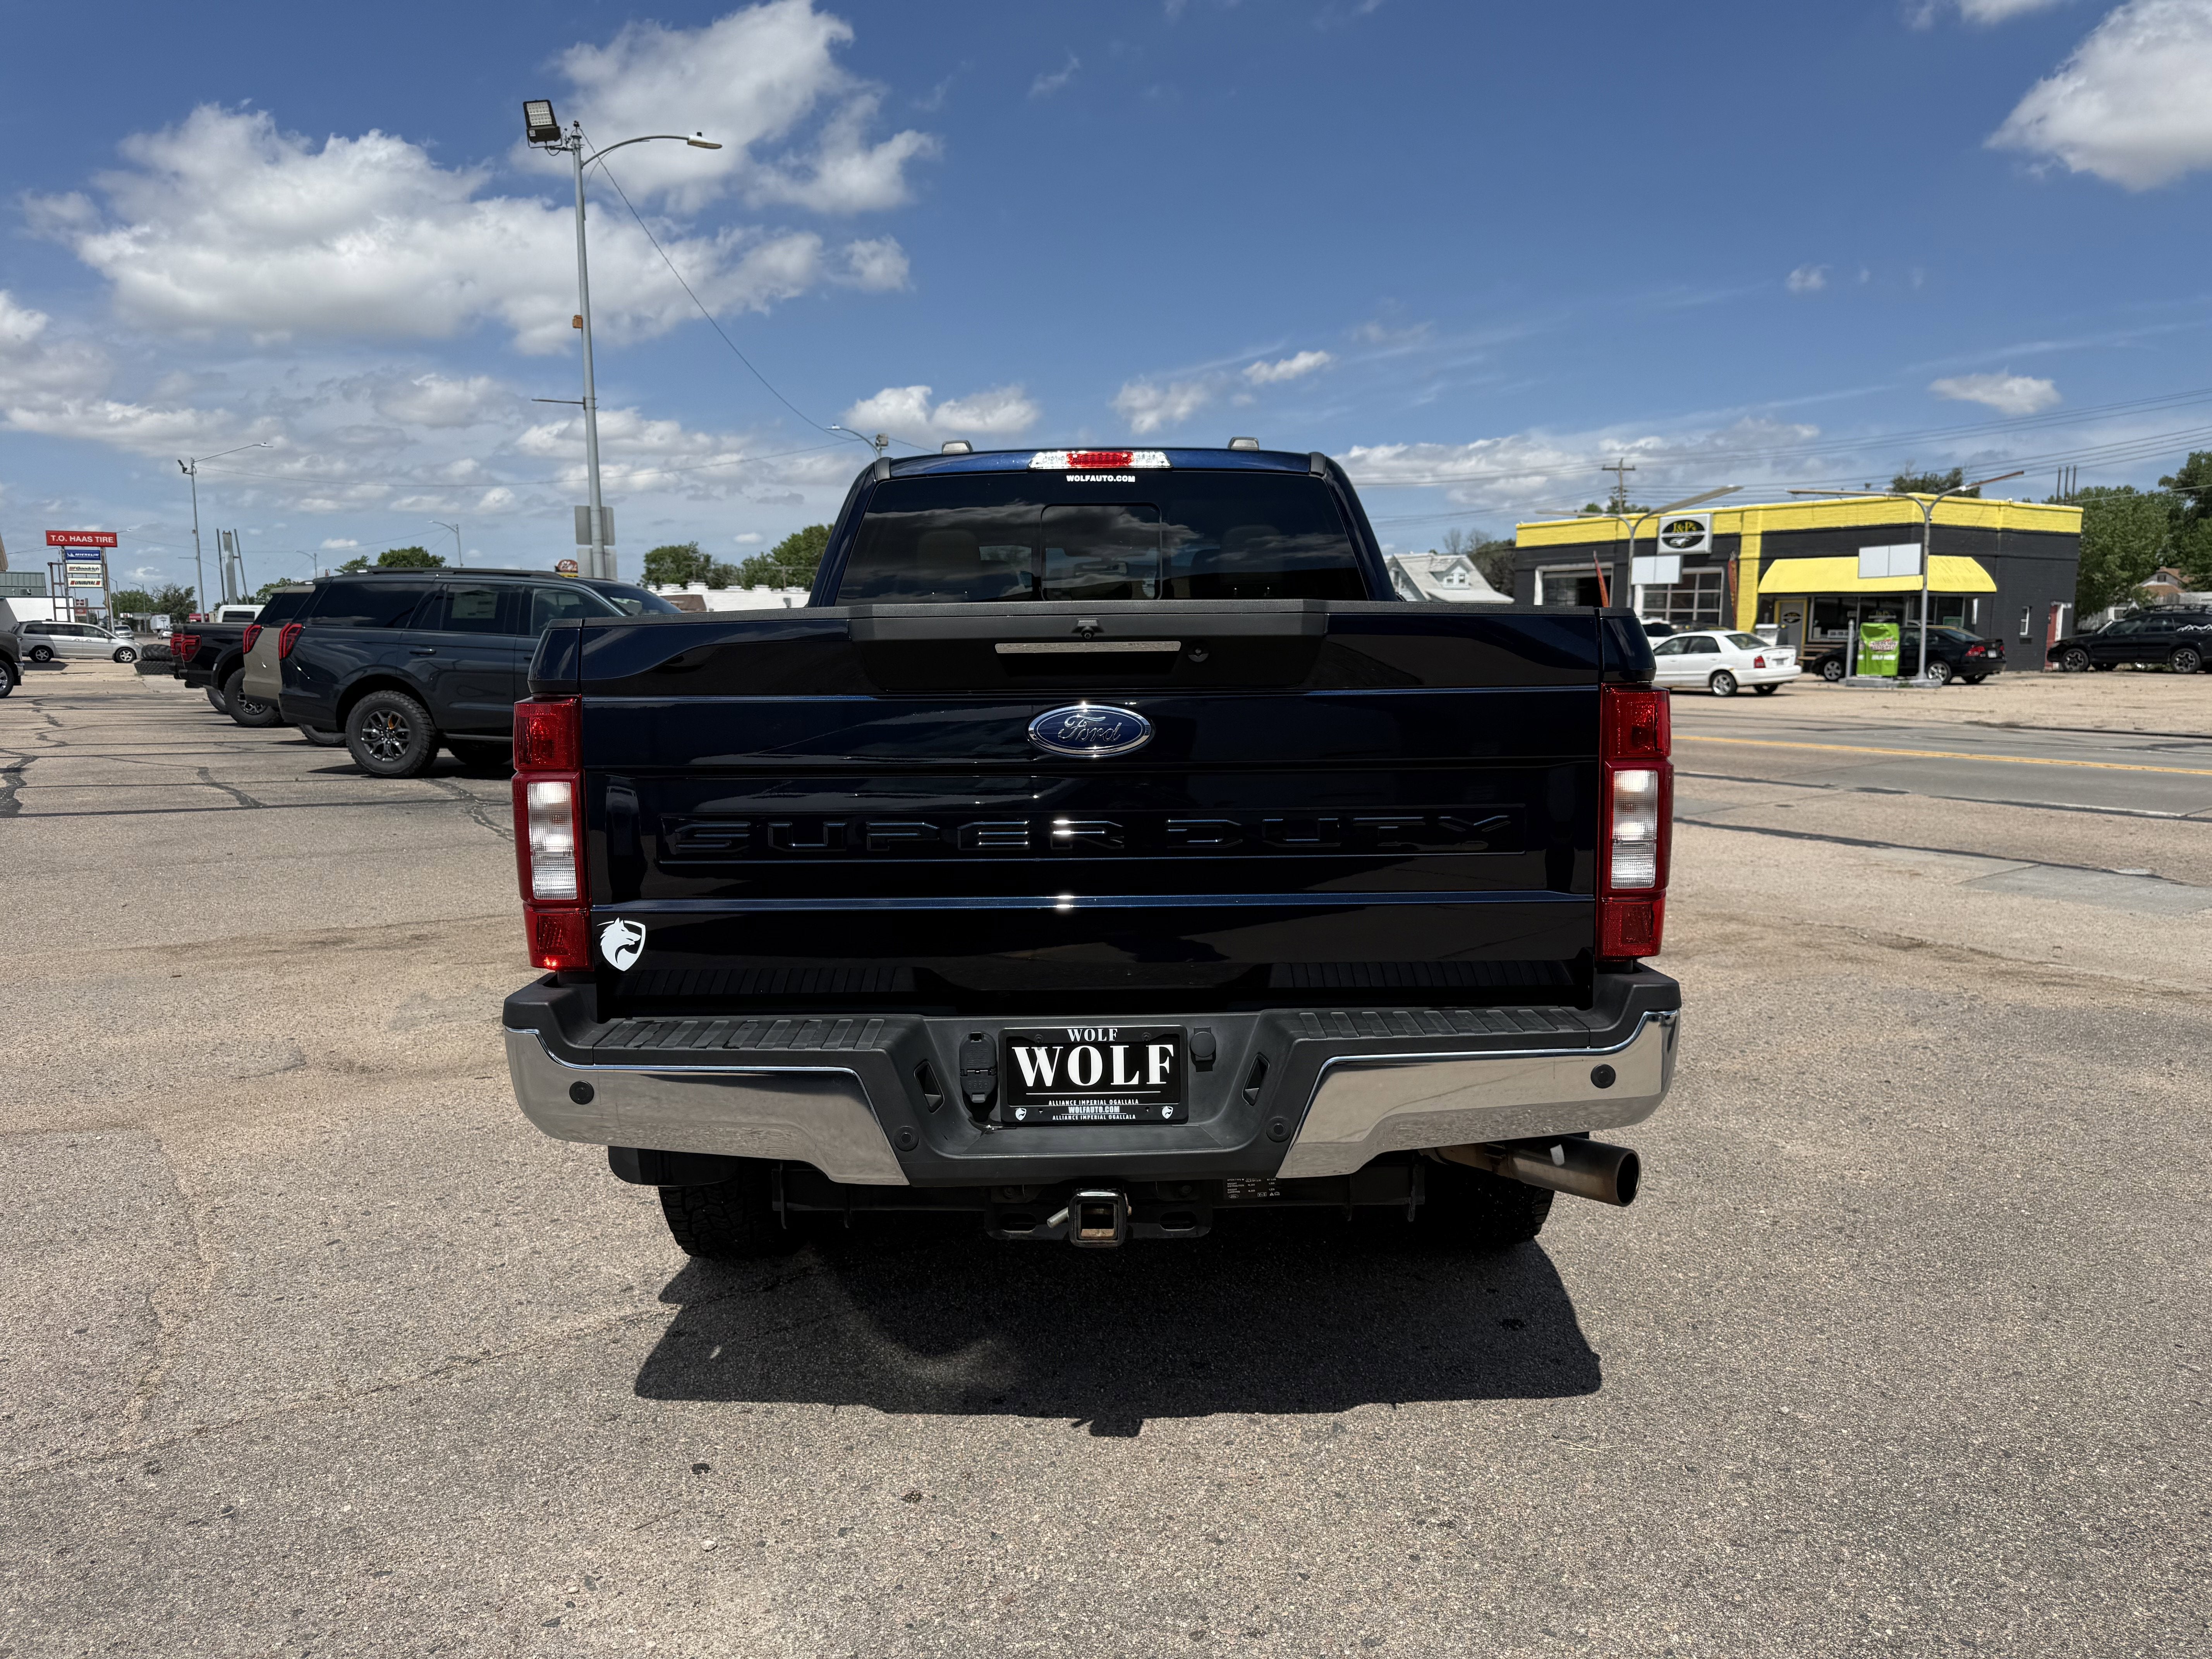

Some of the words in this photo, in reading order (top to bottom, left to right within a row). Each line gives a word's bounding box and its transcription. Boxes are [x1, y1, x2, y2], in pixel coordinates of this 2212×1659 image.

[1058, 713, 1122, 742] Ford
[674, 818, 1125, 853] SUPER
[1165, 815, 1511, 849] DUTY
[1066, 1028, 1118, 1042] WOLF
[1012, 1044, 1175, 1087] WOLF
